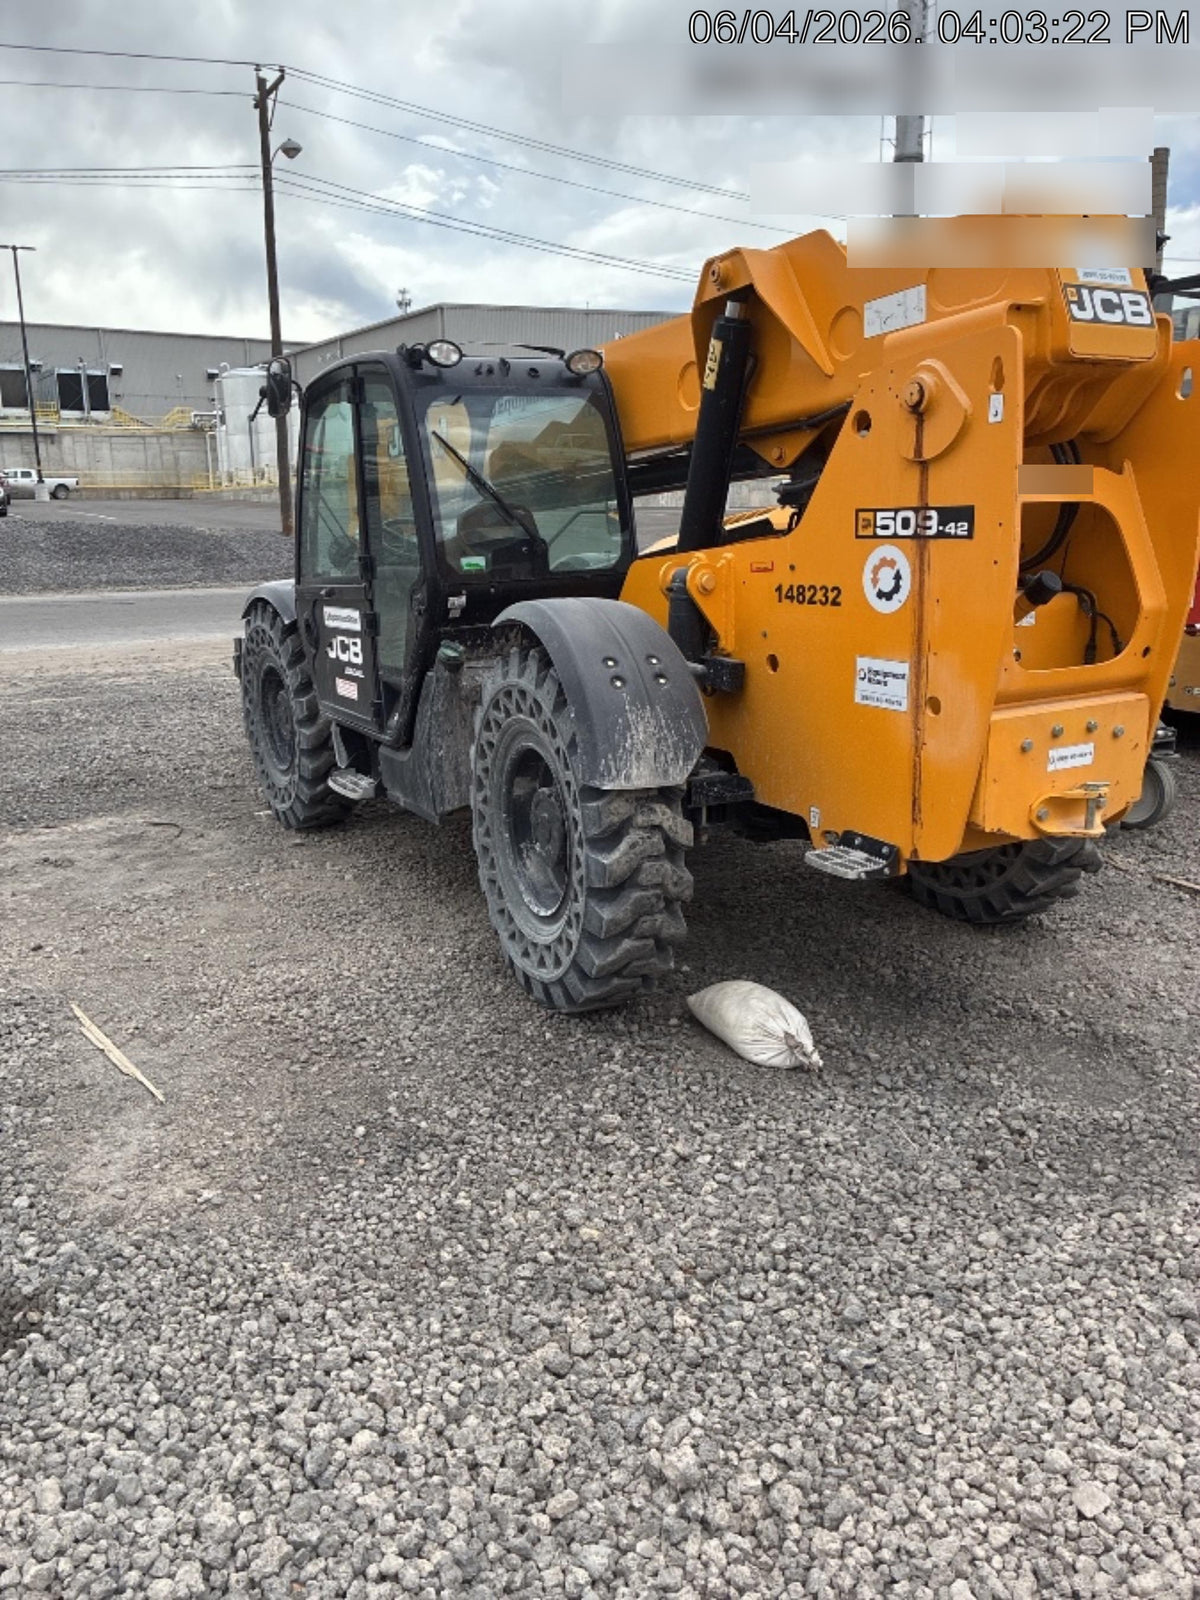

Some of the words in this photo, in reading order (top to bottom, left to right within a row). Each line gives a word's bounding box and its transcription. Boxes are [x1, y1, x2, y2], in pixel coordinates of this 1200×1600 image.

[1069, 287, 1152, 325] JCB
[774, 583, 842, 607] 148232
[325, 635, 363, 665] JCB
